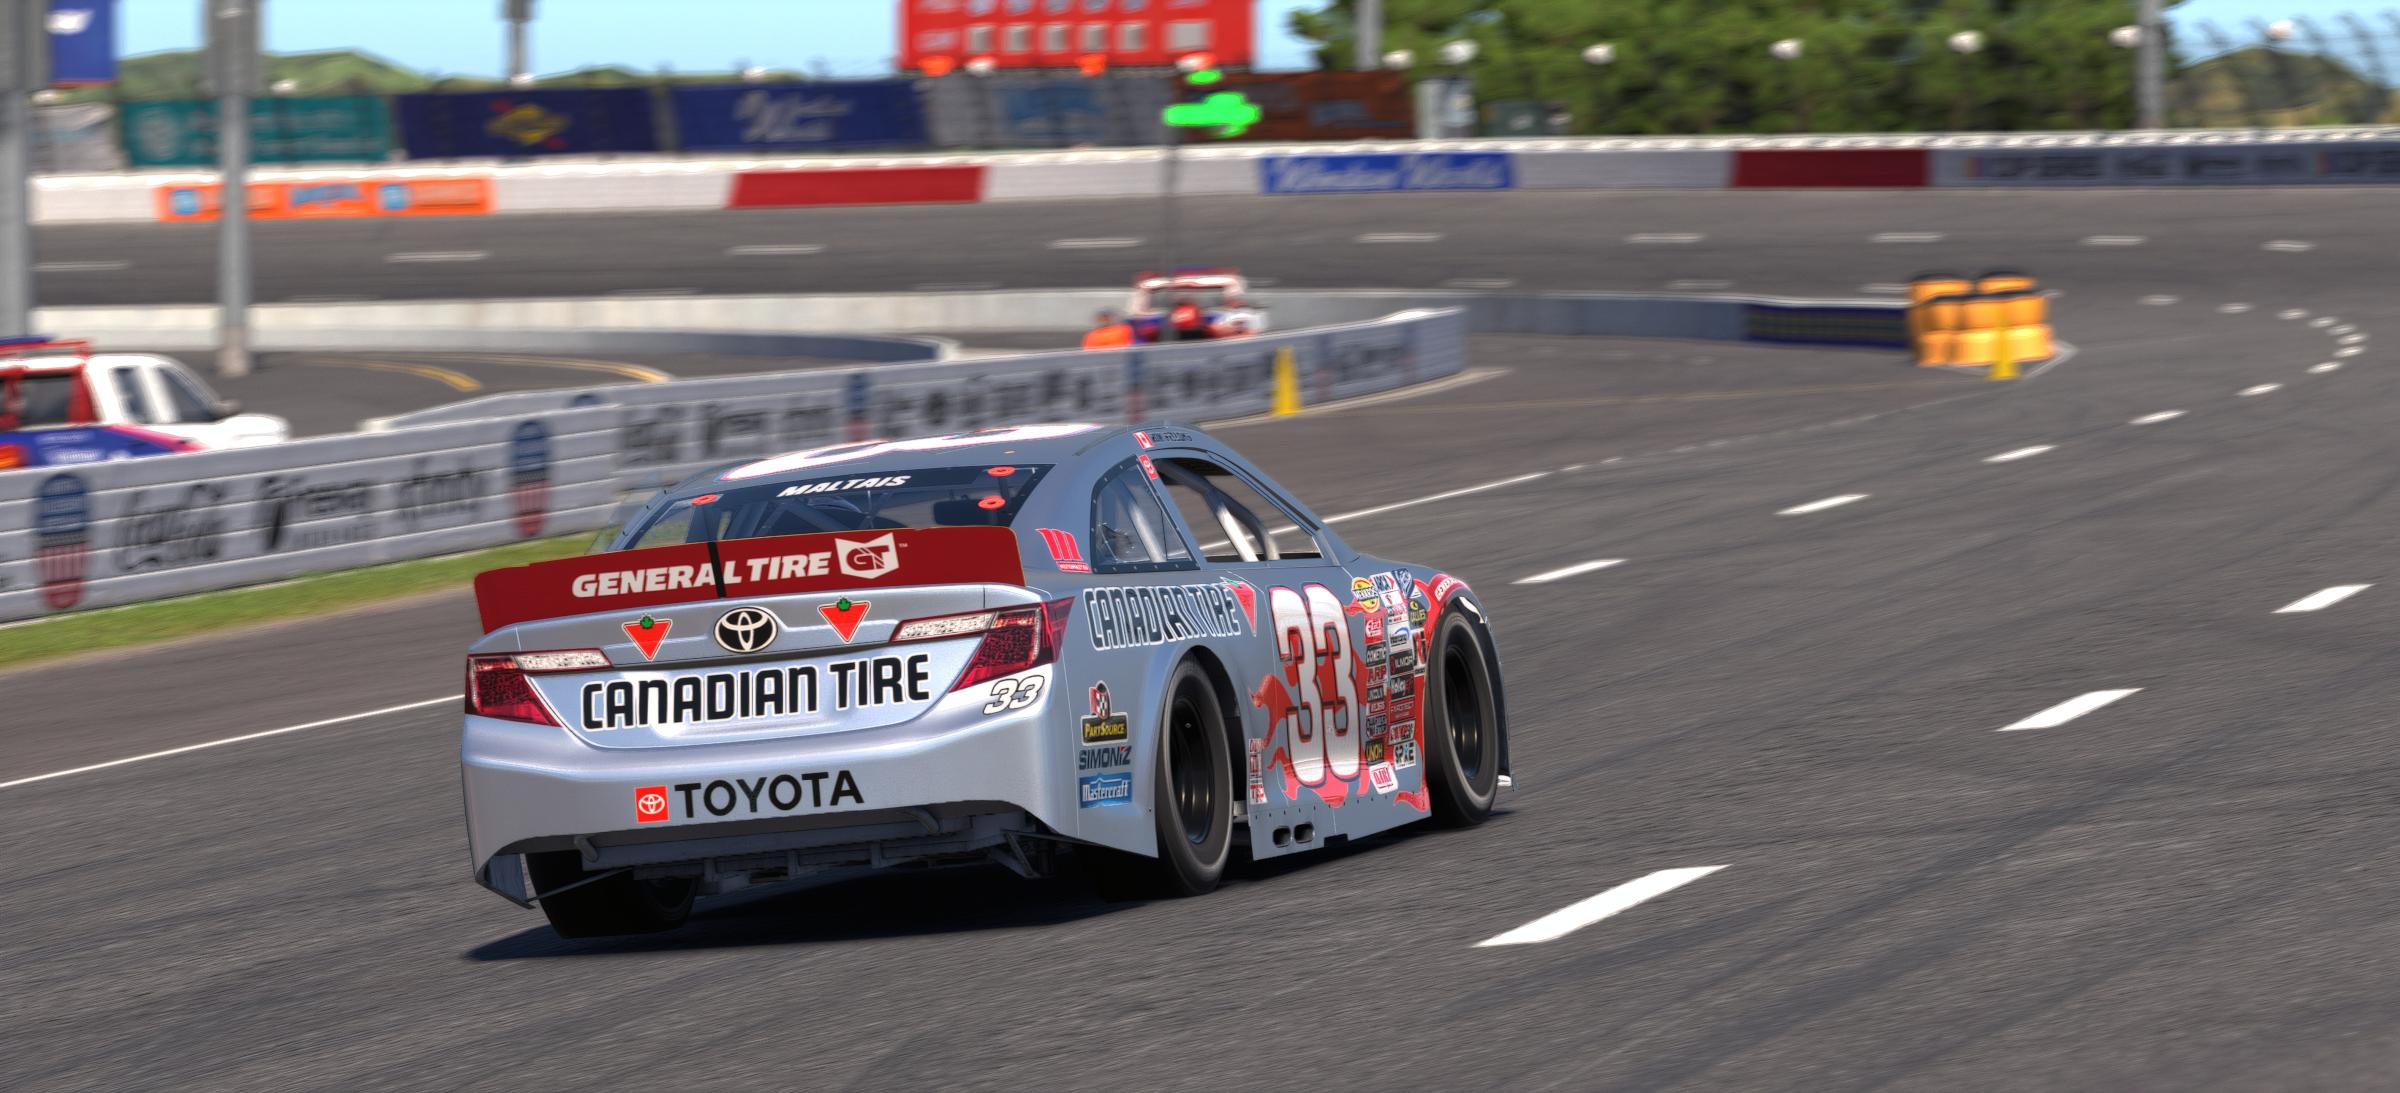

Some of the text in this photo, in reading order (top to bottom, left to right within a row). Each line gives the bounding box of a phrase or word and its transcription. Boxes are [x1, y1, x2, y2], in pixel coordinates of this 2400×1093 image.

[777, 475, 912, 497] MALTAIS
[572, 551, 832, 598] GENERAL TIRE
[1083, 582, 1241, 651] CANADIAN TIRE
[581, 653, 930, 731] CANADIAN TIRE
[983, 674, 1045, 716] 33
[1267, 581, 1361, 788] 33
[674, 770, 864, 819] TOYOTA
[1082, 780, 1129, 802] Mastercraft
